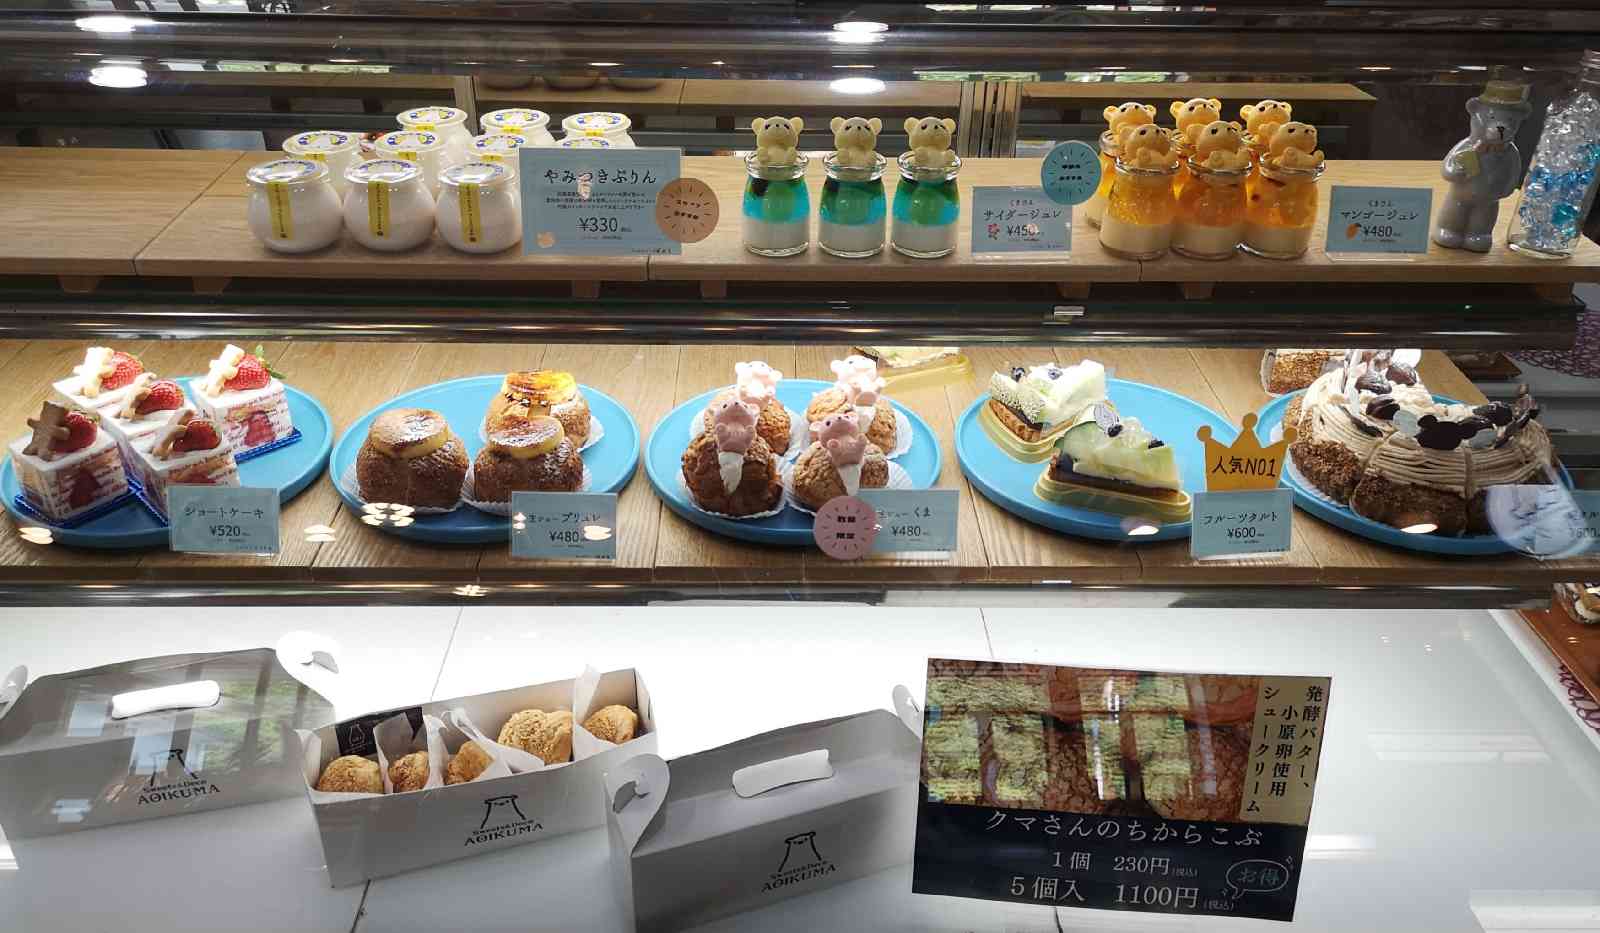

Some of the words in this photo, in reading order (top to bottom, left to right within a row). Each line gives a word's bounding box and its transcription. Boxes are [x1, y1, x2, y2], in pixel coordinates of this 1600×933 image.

[544, 168, 657, 185] やみつきぶりん
[983, 207, 1062, 221] サイダージュレ
[1341, 209, 1419, 221] マンゴージュレ
[576, 216, 619, 233] ¥330
[1362, 225, 1393, 238] ¥480
[184, 504, 264, 520] ショートケーキ
[1201, 511, 1279, 525] フルーツタルト
[209, 525, 241, 537] ¥520
[549, 530, 580, 543] ¥480
[891, 525, 921, 537] ¥480
[1228, 527, 1256, 539] ¥600
[1246, 686, 1280, 813] シュークリーム
[1270, 704, 1298, 797] 小原卵使用
[138, 784, 220, 805] AOIKUMA
[464, 823, 543, 847] AOIKUMA
[985, 810, 1263, 846] クマさんのちからこぶ
[1052, 851, 1091, 871] 1個
[1112, 855, 1171, 876] 230円
[1238, 866, 1280, 886] お得
[1010, 876, 1086, 902] 5個入
[1115, 883, 1200, 909] 1100円
